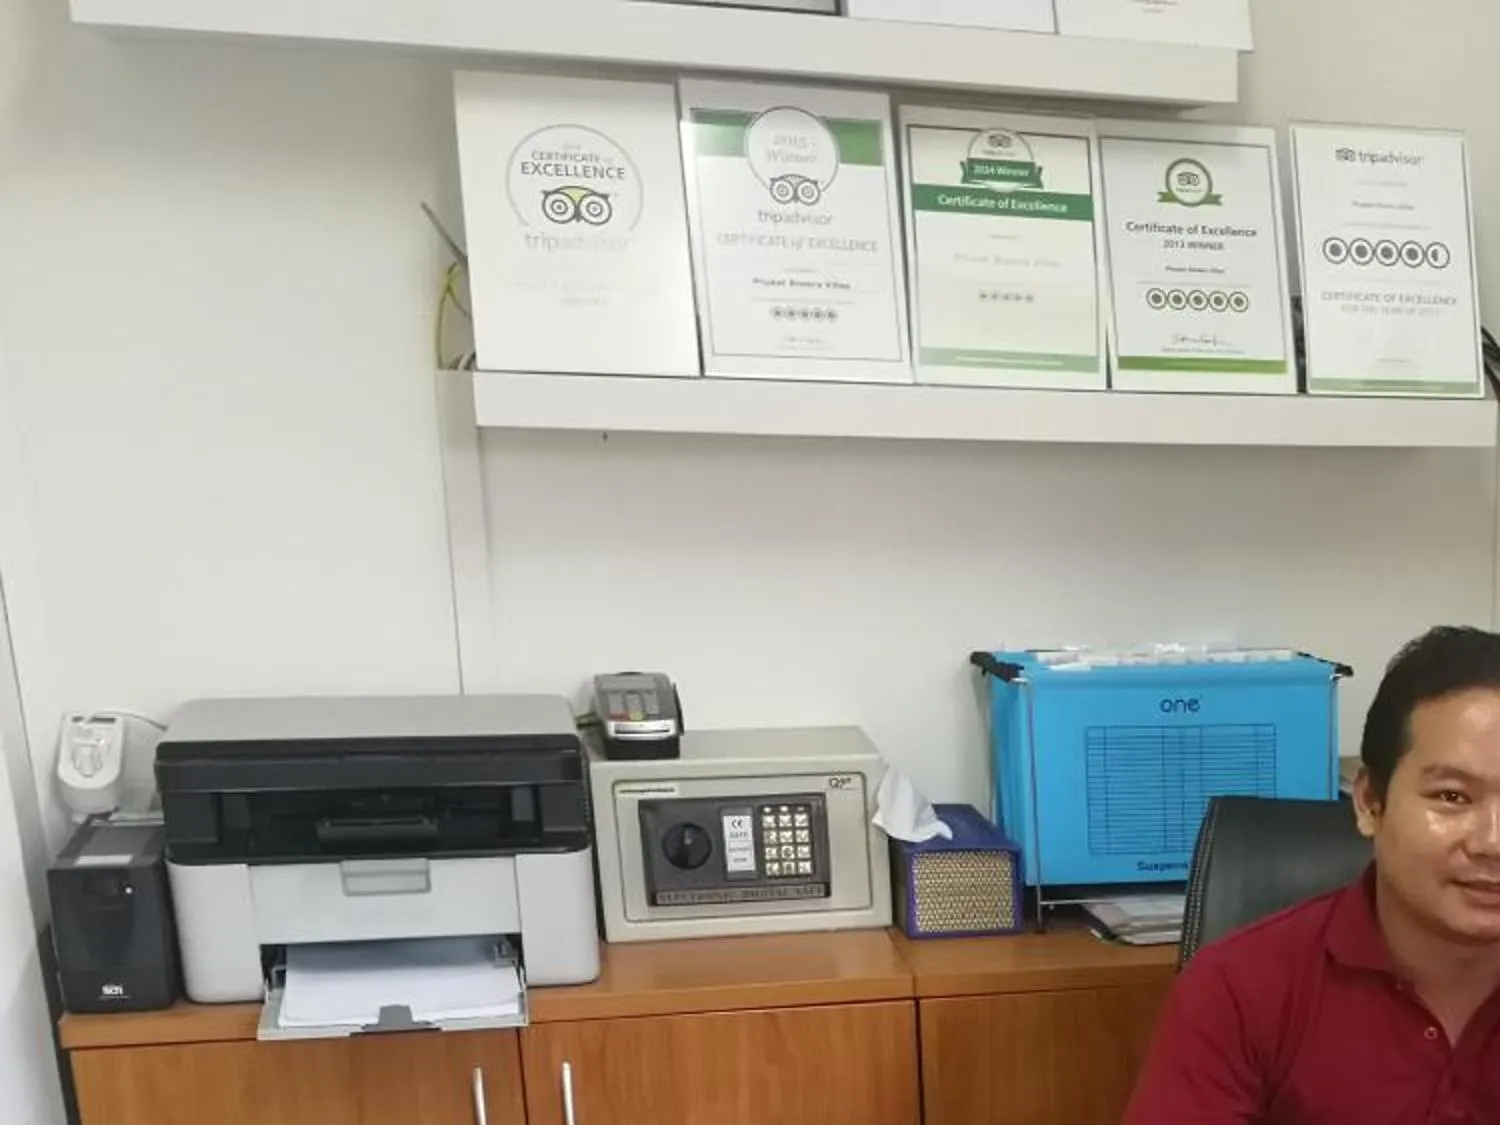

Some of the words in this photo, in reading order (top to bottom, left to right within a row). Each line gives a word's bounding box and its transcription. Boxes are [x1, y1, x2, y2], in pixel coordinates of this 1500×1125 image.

[1358, 150, 1424, 167] tripadvisor
[520, 161, 625, 180] EXCELLENCE
[938, 194, 995, 209] Certificate
[997, 198, 1010, 210] of
[1011, 199, 1069, 213] Excellence
[1125, 221, 1184, 236] Certificate
[1187, 223, 1199, 236] of
[1201, 225, 1258, 238] Excellence
[1160, 696, 1200, 714] one
